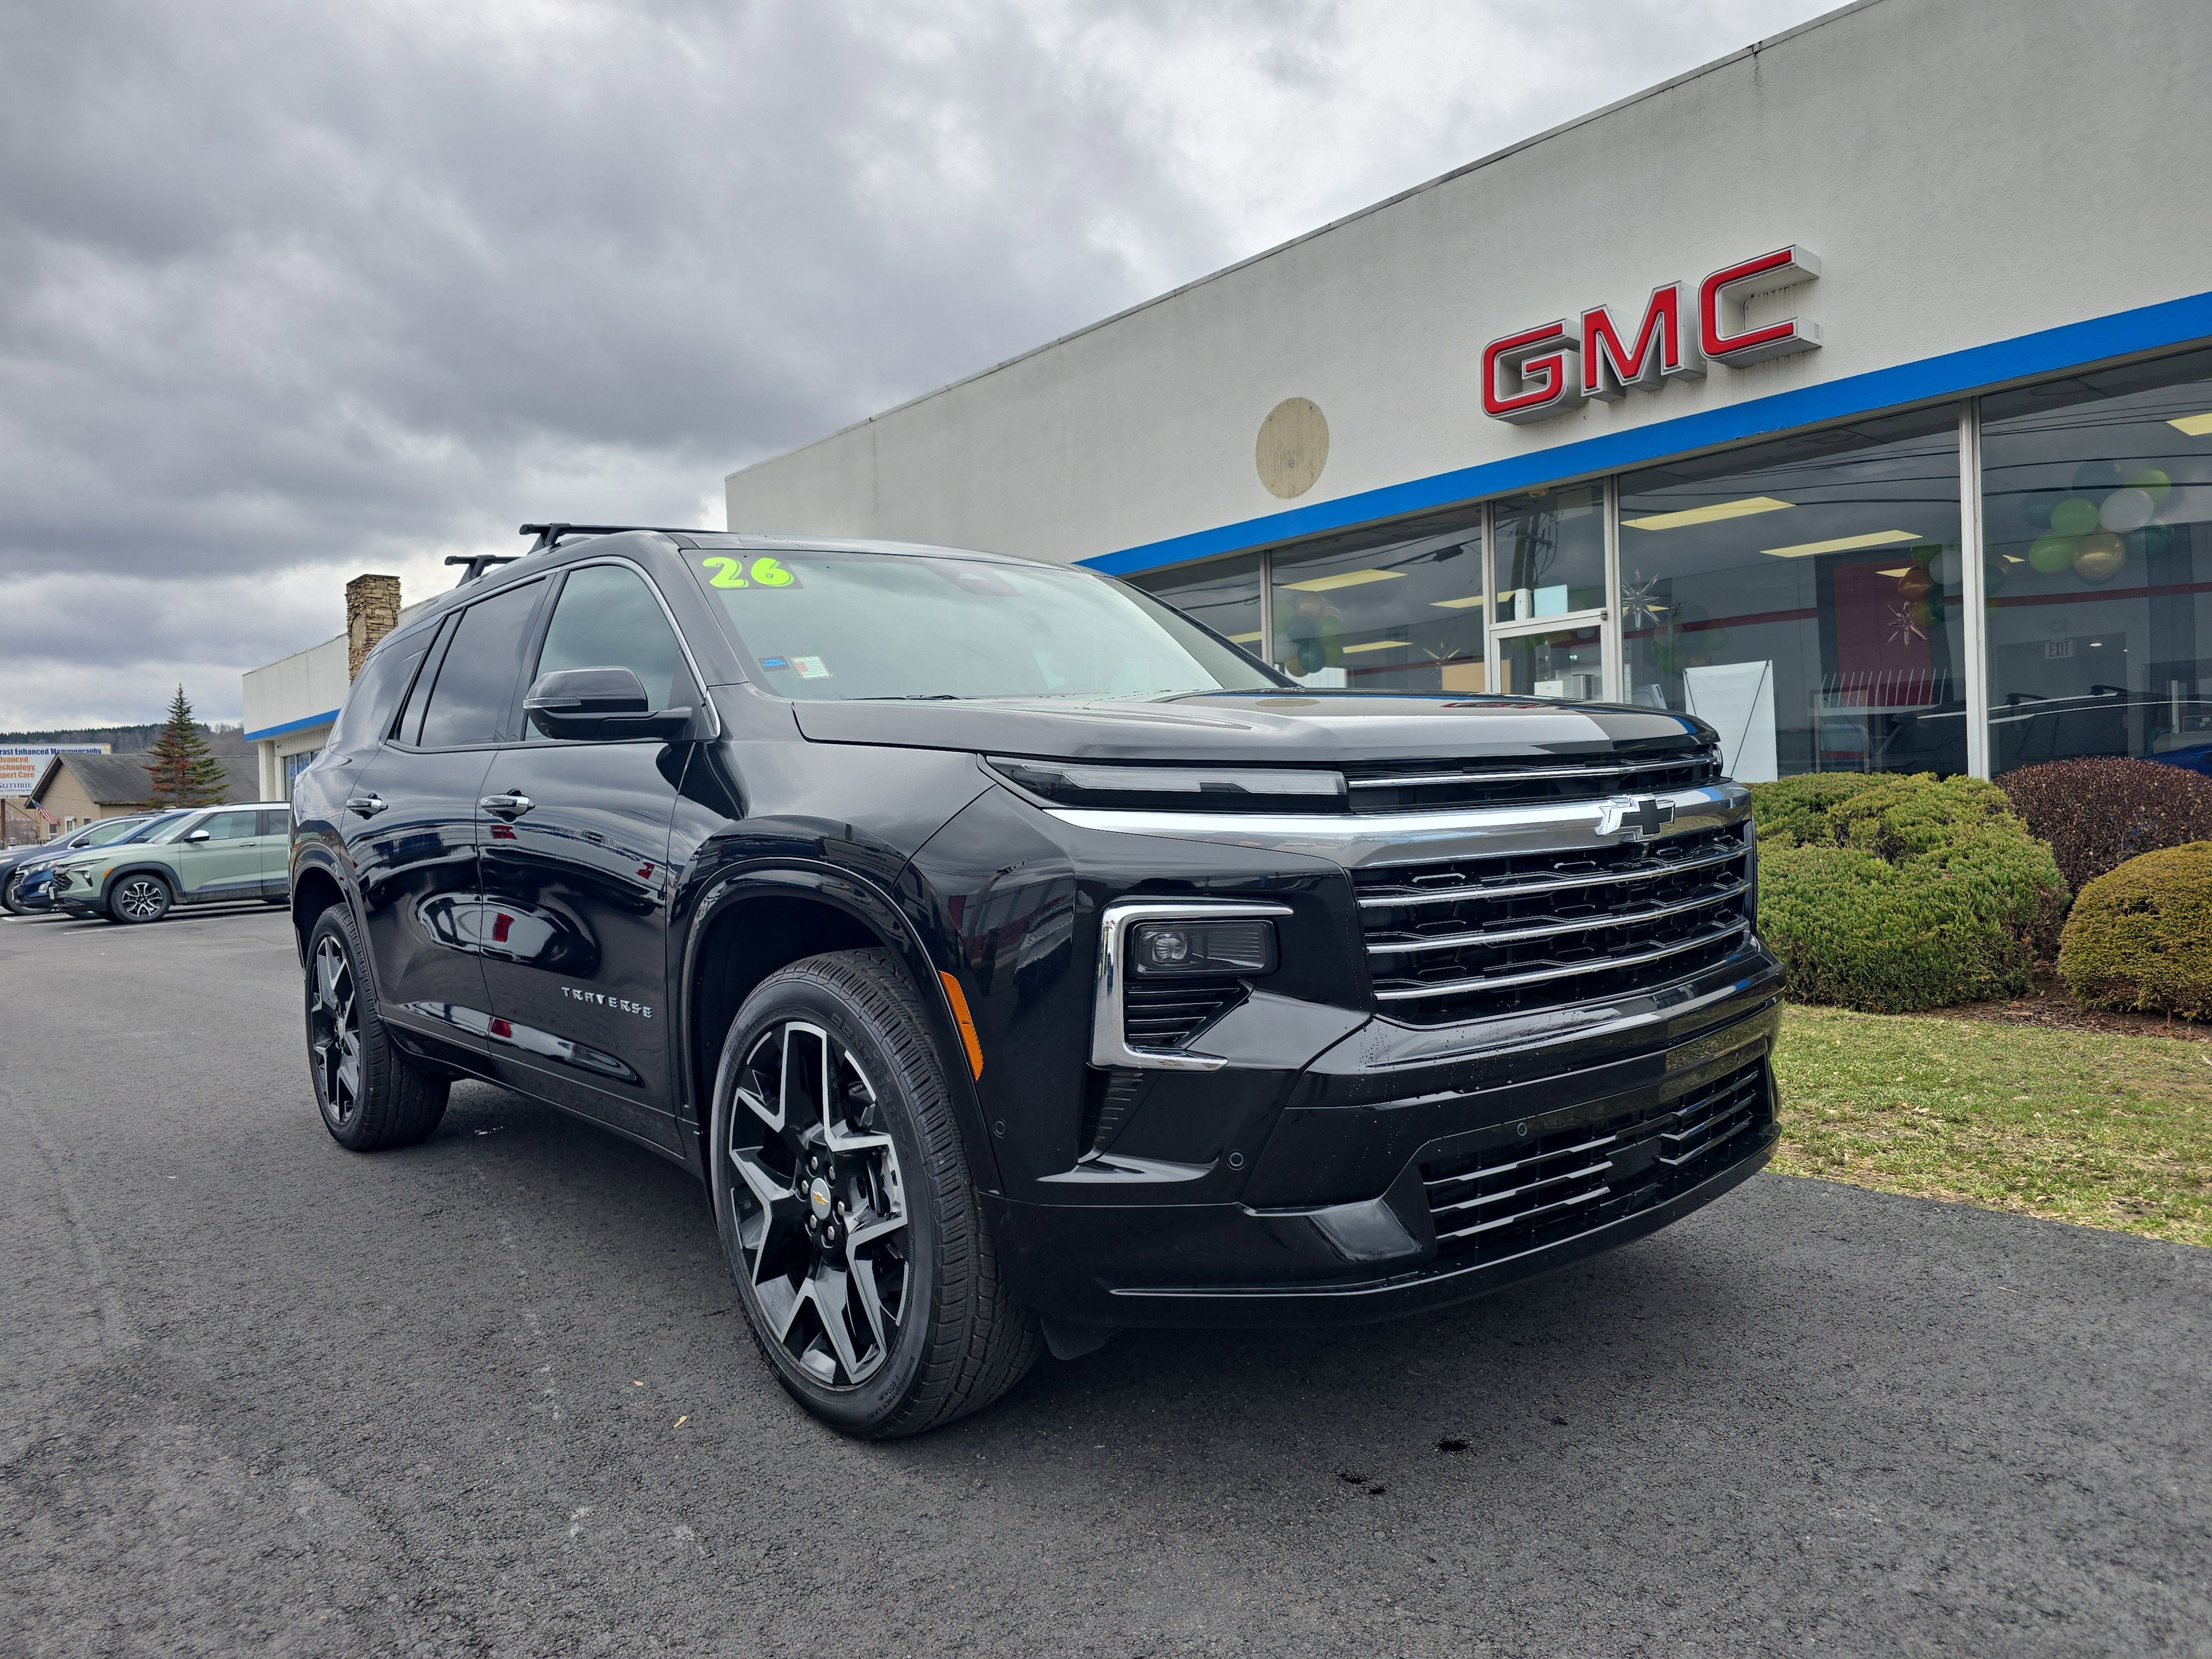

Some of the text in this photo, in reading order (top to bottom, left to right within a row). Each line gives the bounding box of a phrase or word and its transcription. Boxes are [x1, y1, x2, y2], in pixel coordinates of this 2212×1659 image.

[1481, 244, 1799, 419] GMC
[703, 557, 794, 589] 26
[2049, 641, 2070, 657] EXIT
[561, 987, 653, 1018] TRAVERSE
